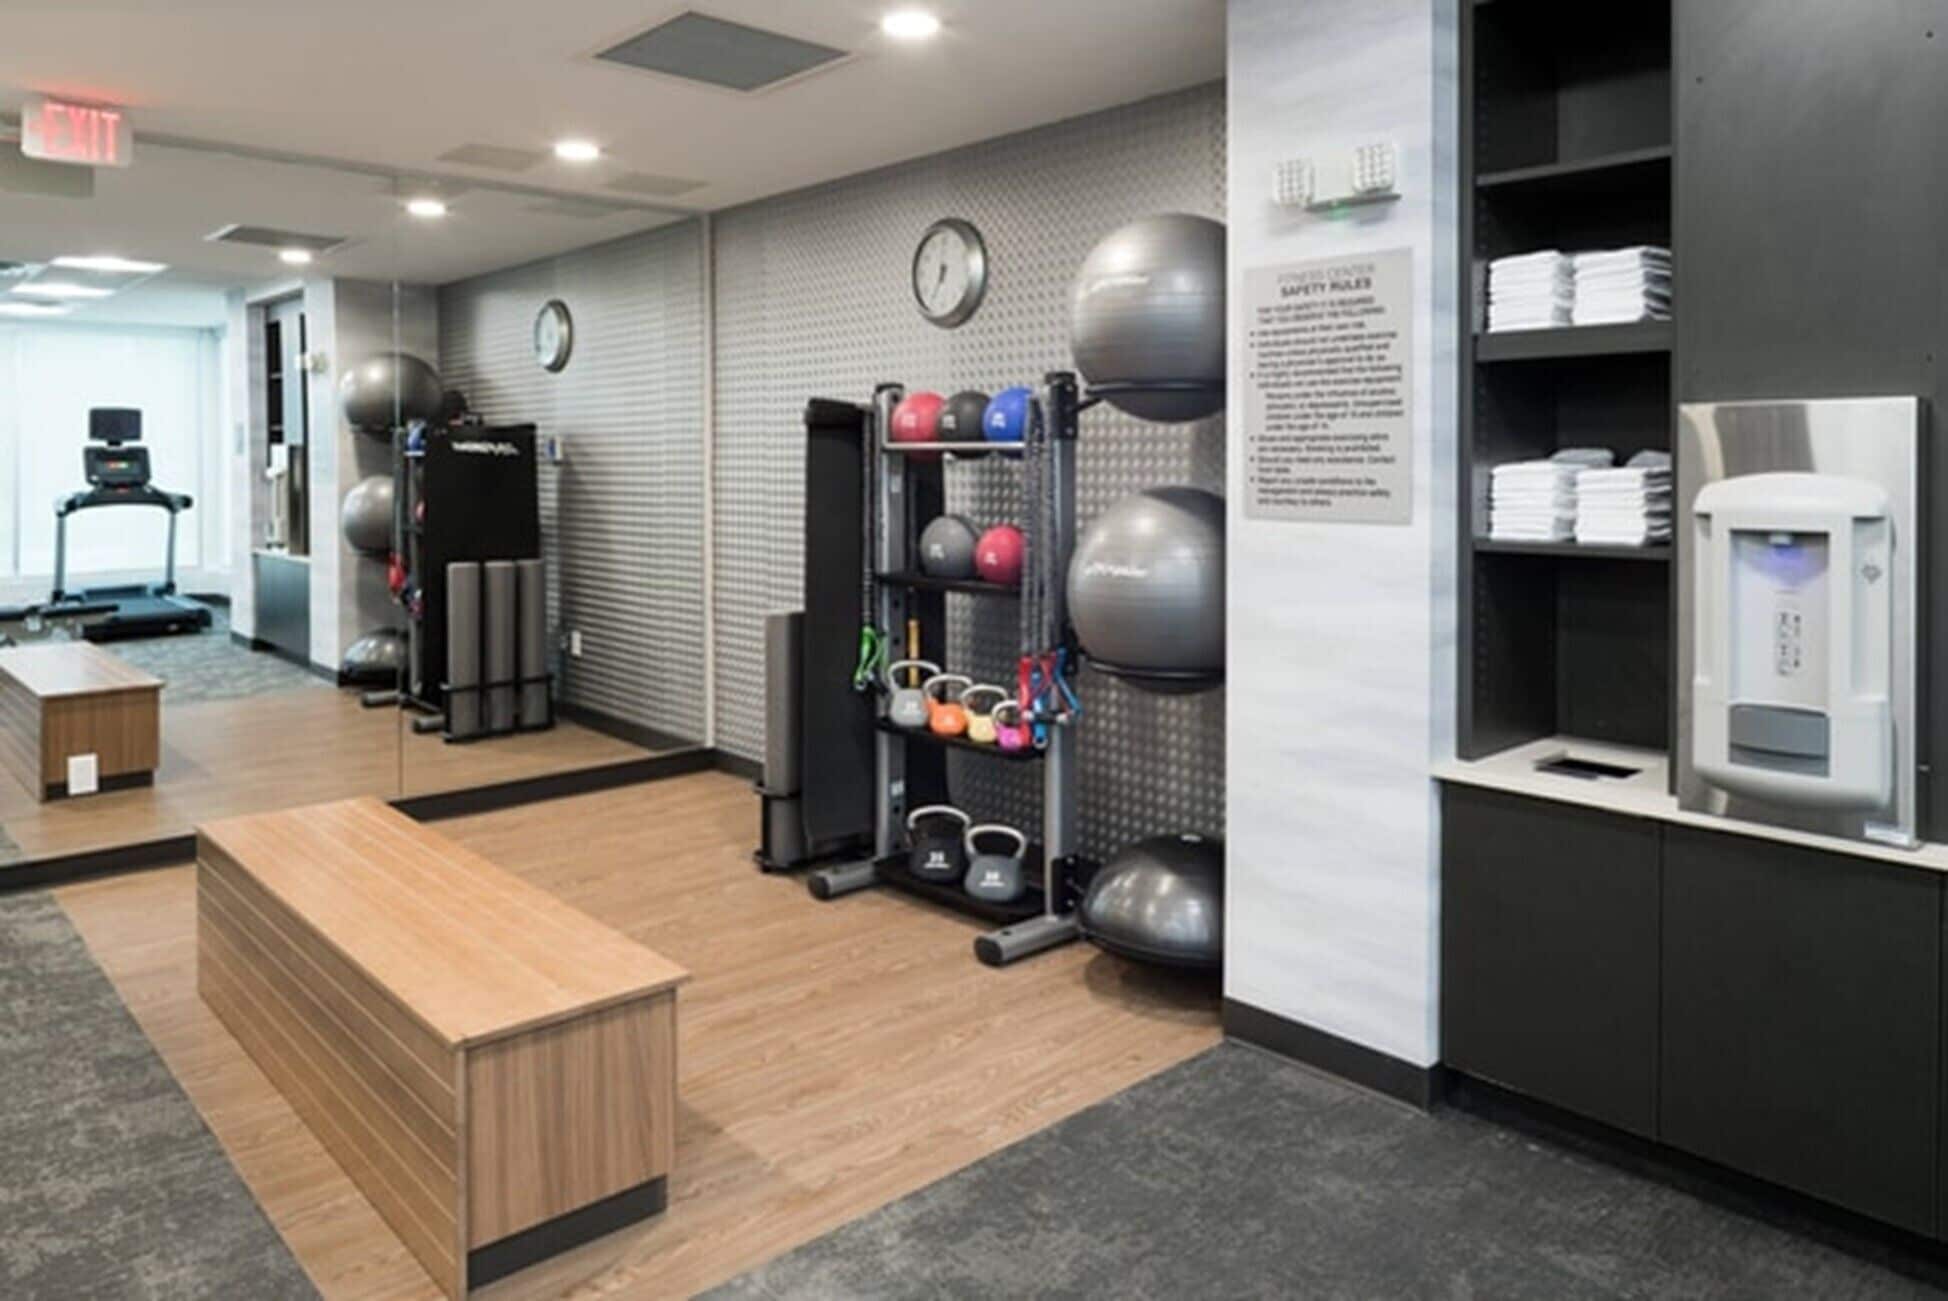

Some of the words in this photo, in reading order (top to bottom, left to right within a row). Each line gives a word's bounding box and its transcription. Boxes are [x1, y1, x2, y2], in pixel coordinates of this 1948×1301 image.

[42, 102, 121, 162] EXIT
[1327, 263, 1375, 280] CENTER
[1281, 282, 1327, 297] SAFETY
[1329, 276, 1372, 292] RULES
